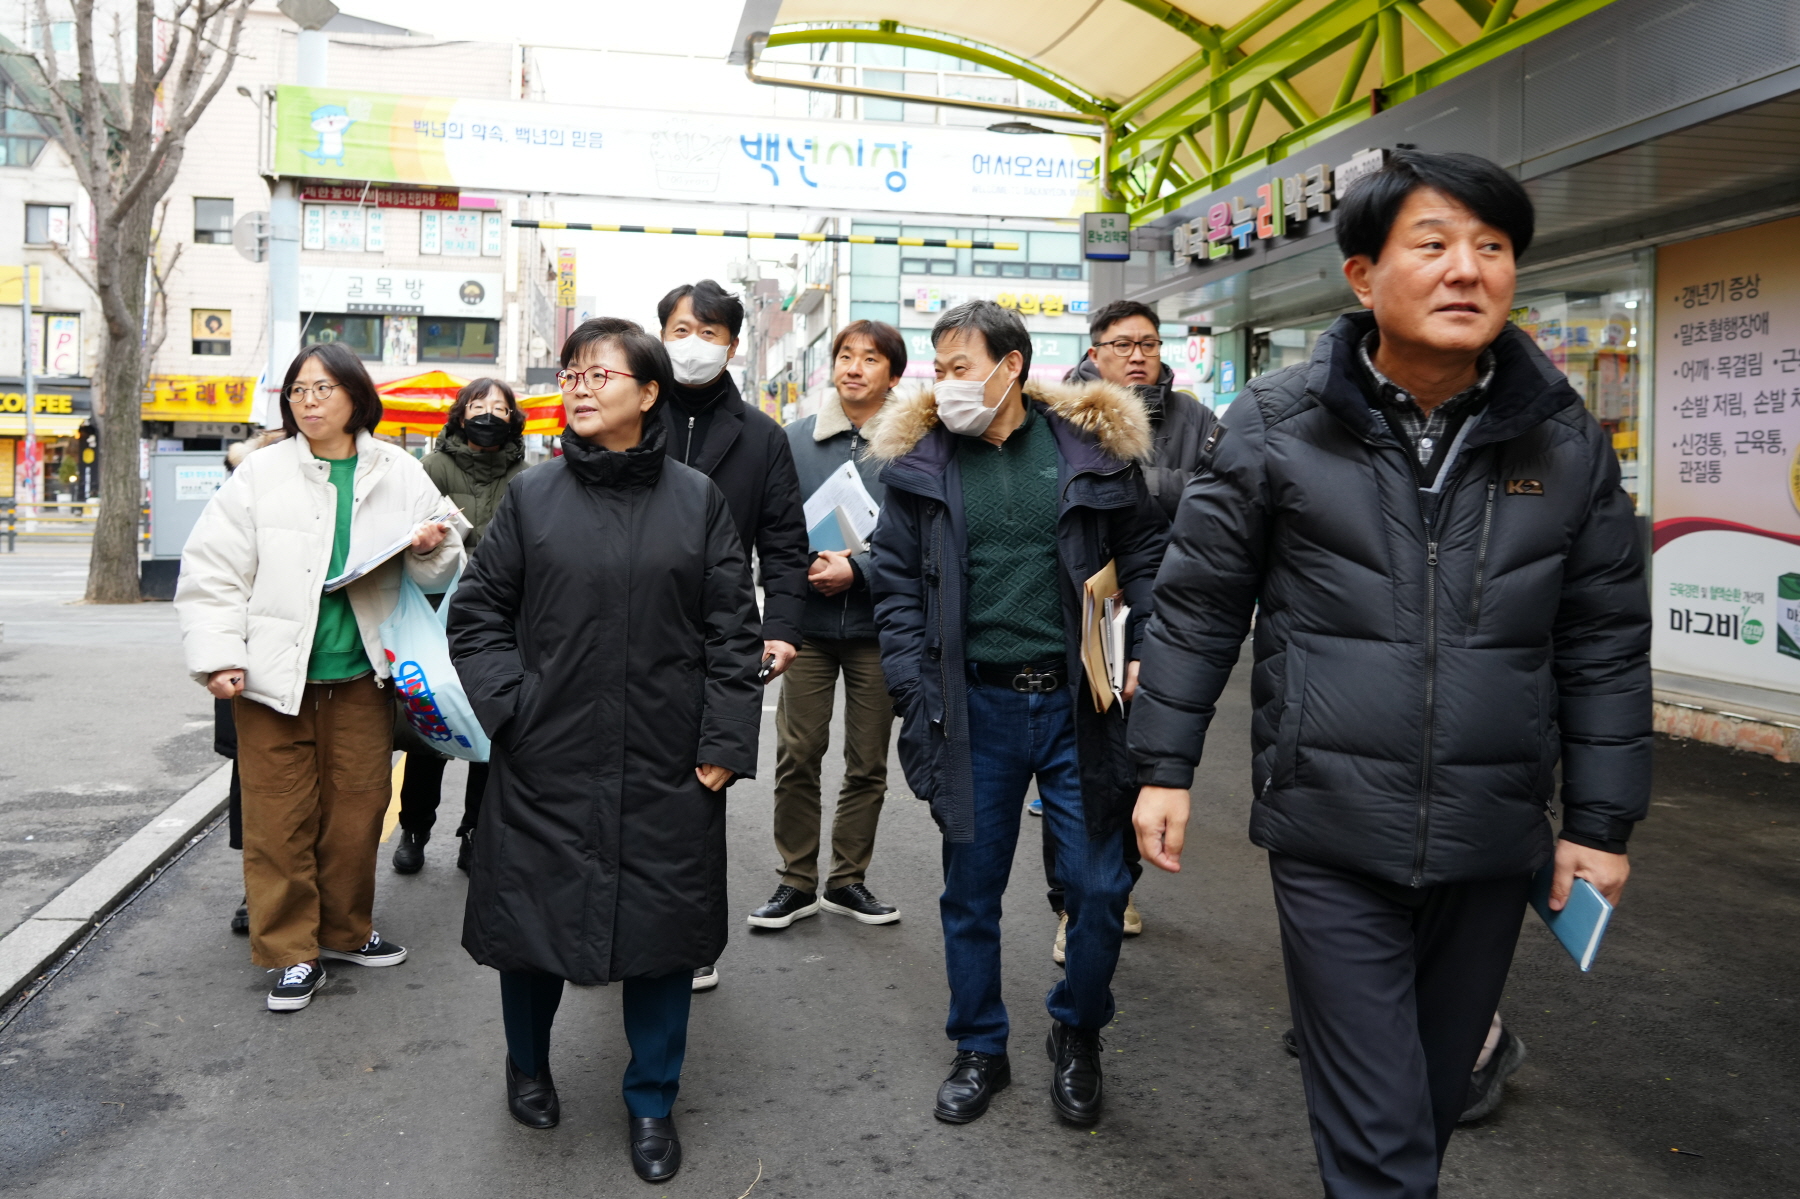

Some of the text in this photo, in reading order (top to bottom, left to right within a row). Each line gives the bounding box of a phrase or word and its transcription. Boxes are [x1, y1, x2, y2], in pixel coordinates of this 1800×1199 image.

[413, 120, 464, 139] 백년의
[516, 127, 564, 146] 백년의
[572, 131, 603, 149] 믿음
[739, 133, 912, 192] 백년시장
[972, 153, 1096, 180] 어서오십시오
[1087, 230, 1129, 243] 온누리약국
[348, 276, 425, 300] 골목방
[1682, 273, 1762, 309] 갱년기 증상
[1680, 311, 1770, 347] 말초혈행장애
[1780, 348, 1800, 374] 근
[0, 392, 73, 414] OFEE
[165, 380, 247, 405] 노래방
[1680, 395, 1710, 419] 손발
[1713, 392, 1747, 418] 저림,
[1753, 388, 1787, 415] 손발
[1680, 429, 1787, 458] 신경통, 근육통,
[1679, 460, 1722, 484] 관절통
[1506, 479, 1544, 494] K2
[1669, 608, 1739, 640] 마그비
